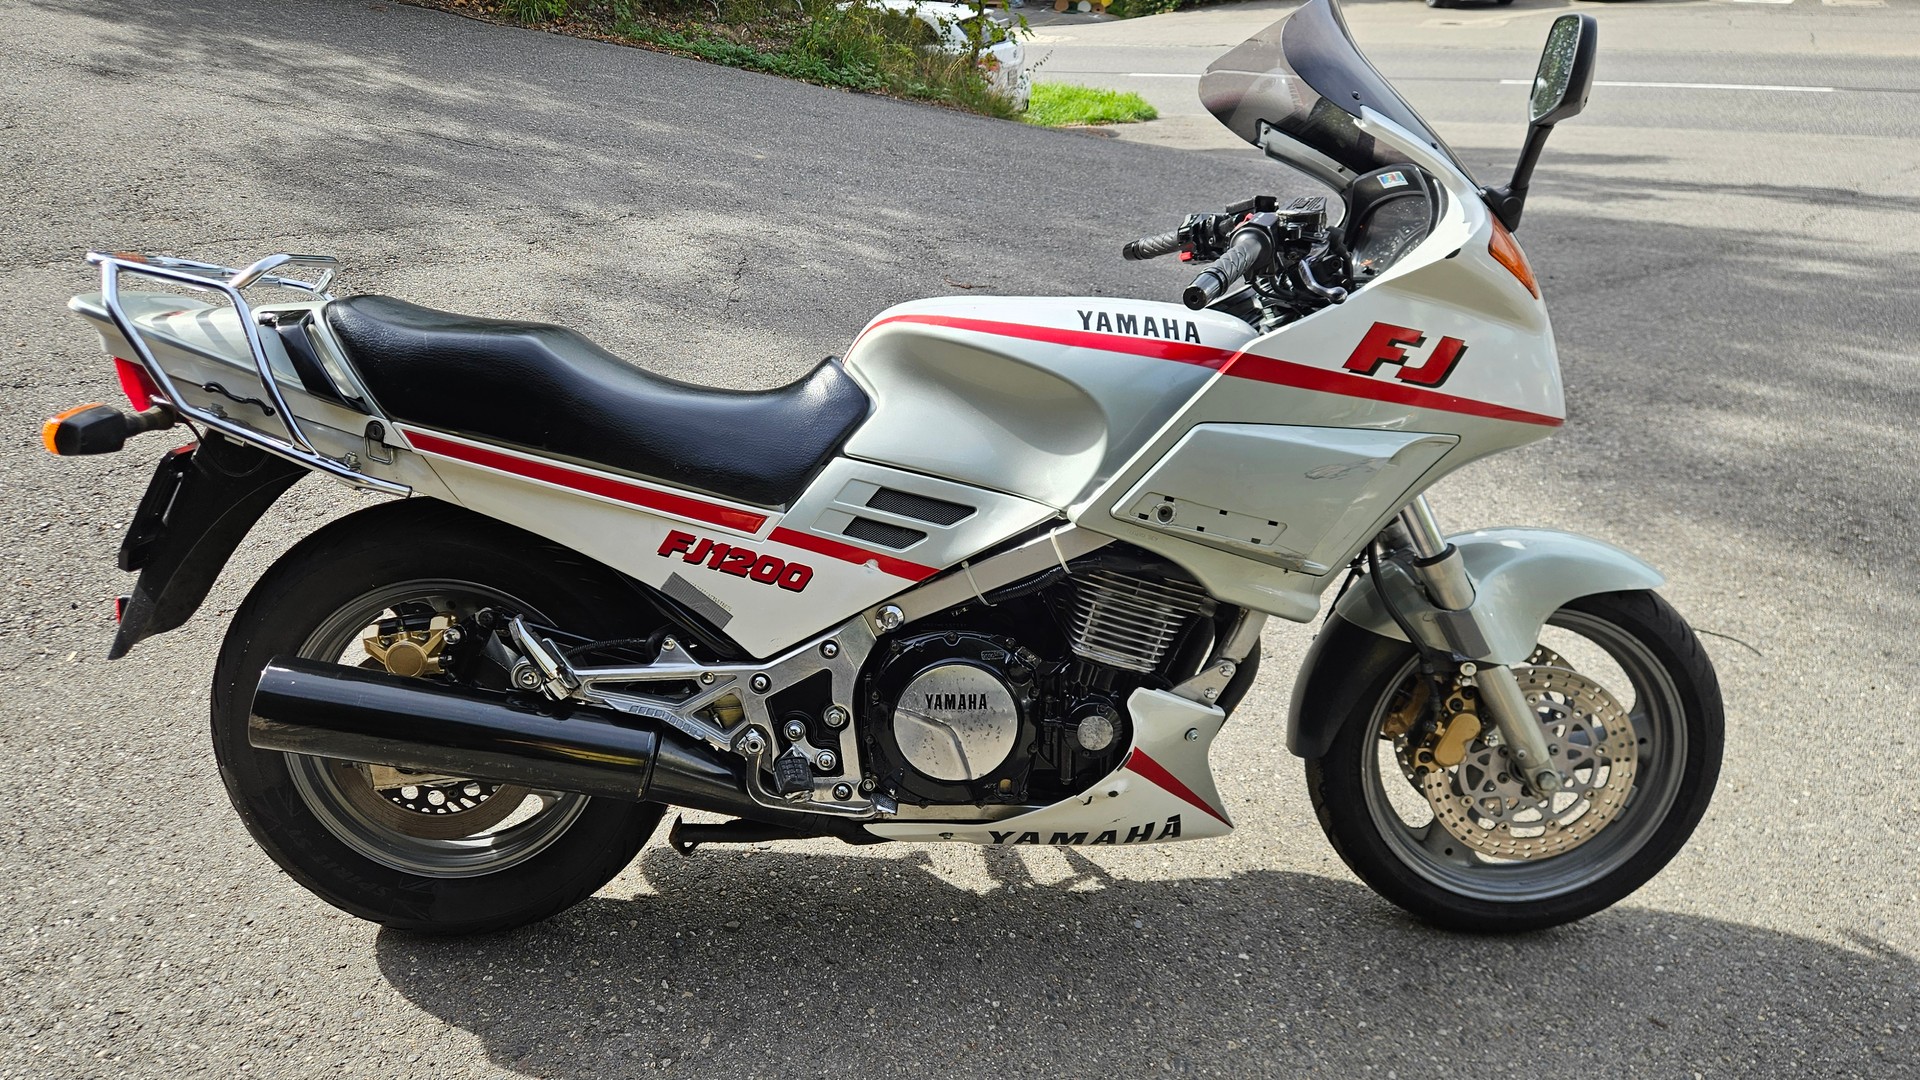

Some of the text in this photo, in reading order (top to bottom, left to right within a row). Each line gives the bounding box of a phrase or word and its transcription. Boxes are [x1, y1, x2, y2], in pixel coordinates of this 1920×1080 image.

[1077, 309, 1201, 344] YAMAHA
[1342, 321, 1469, 388] FJ
[657, 529, 814, 593] FJ1200
[925, 693, 988, 710] YAMAHA
[988, 804, 1181, 845] YAMAHA
